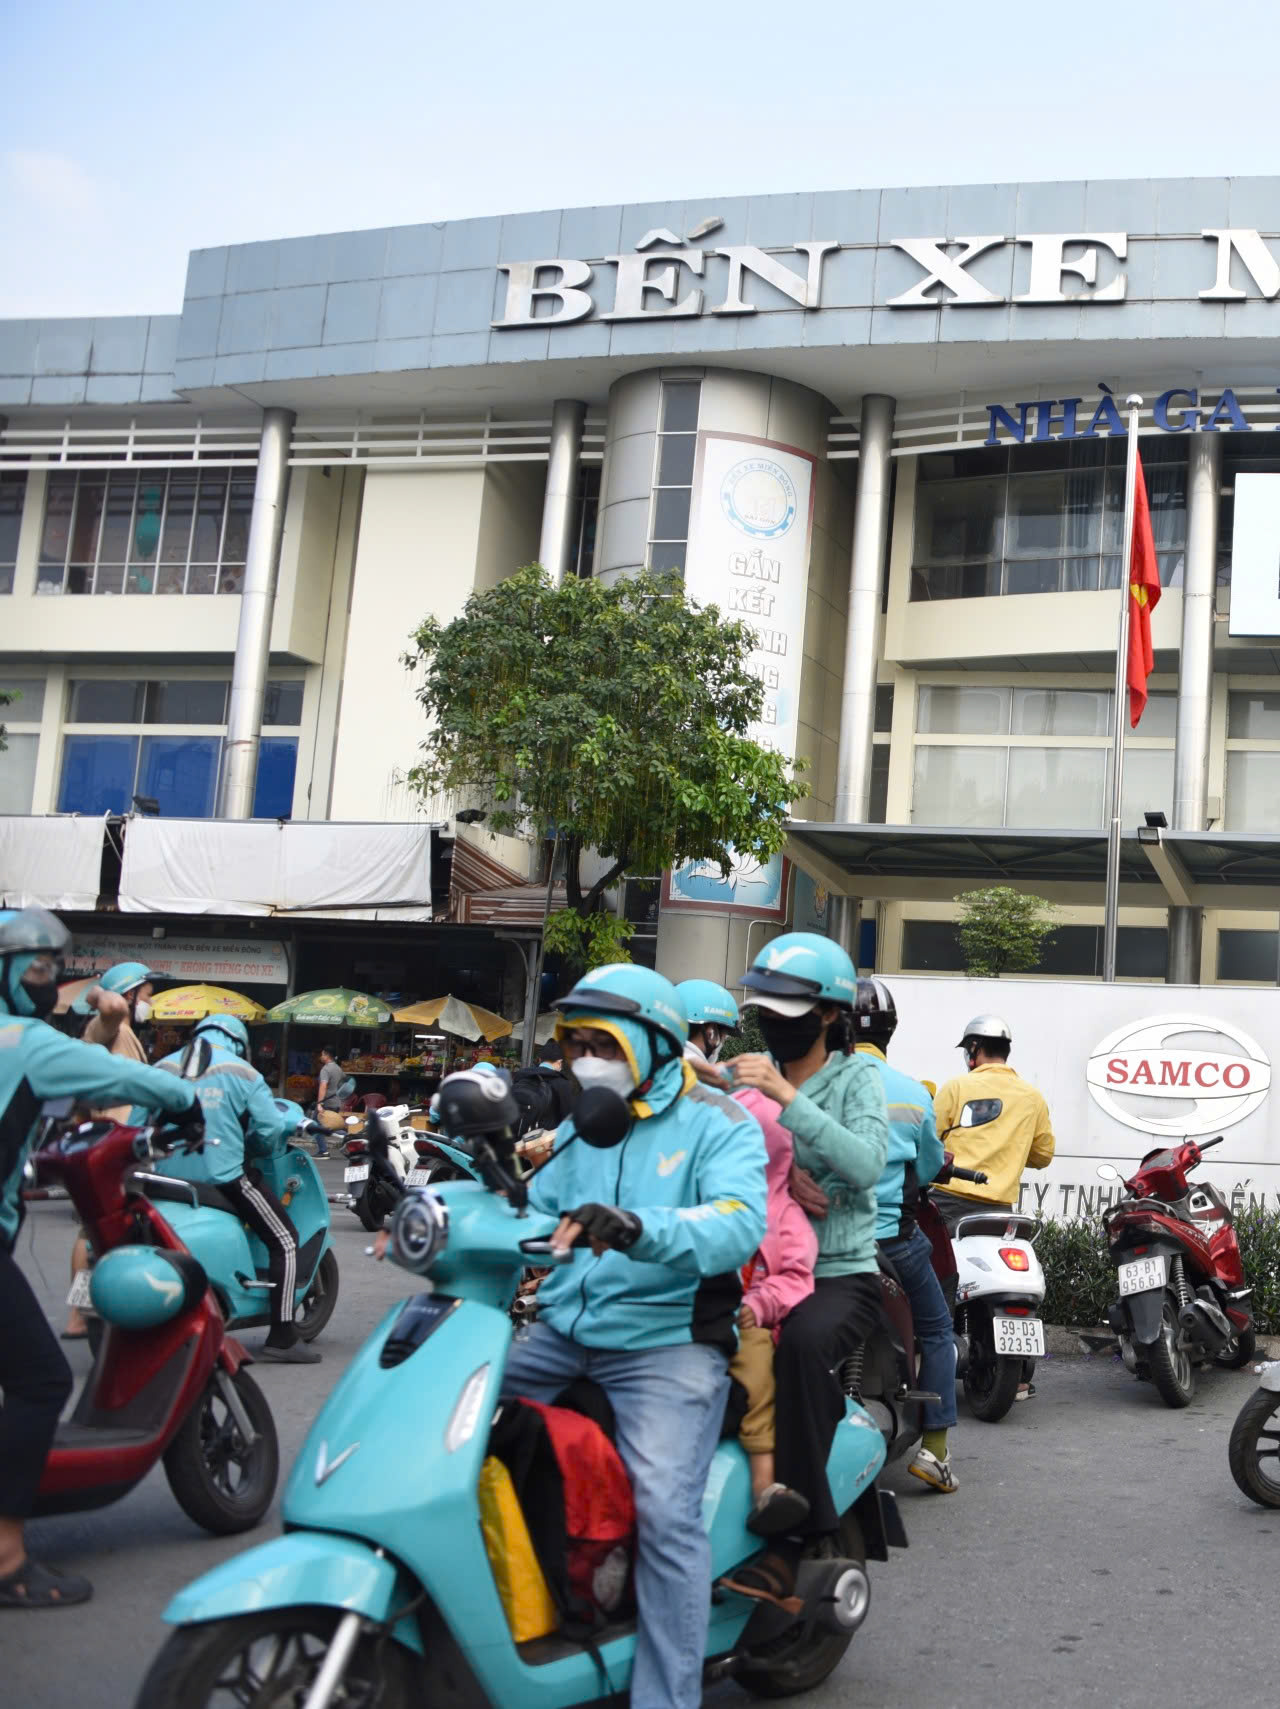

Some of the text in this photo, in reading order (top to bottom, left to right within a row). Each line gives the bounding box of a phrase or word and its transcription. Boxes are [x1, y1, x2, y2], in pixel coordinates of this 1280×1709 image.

[490, 216, 842, 329] BẾN
[886, 232, 1129, 309] XE
[984, 382, 1129, 446] NHÀ
[1153, 387, 1252, 433] GA
[728, 549, 781, 584] GẮN
[728, 585, 776, 617] KẾT
[1106, 1058, 1251, 1089] SAMCO
[1122, 1272, 1163, 1293] 956.61
[1126, 1260, 1157, 1279] 63-B1
[1002, 1320, 1036, 1337] 59-D3
[999, 1337, 1040, 1353] 323.51
